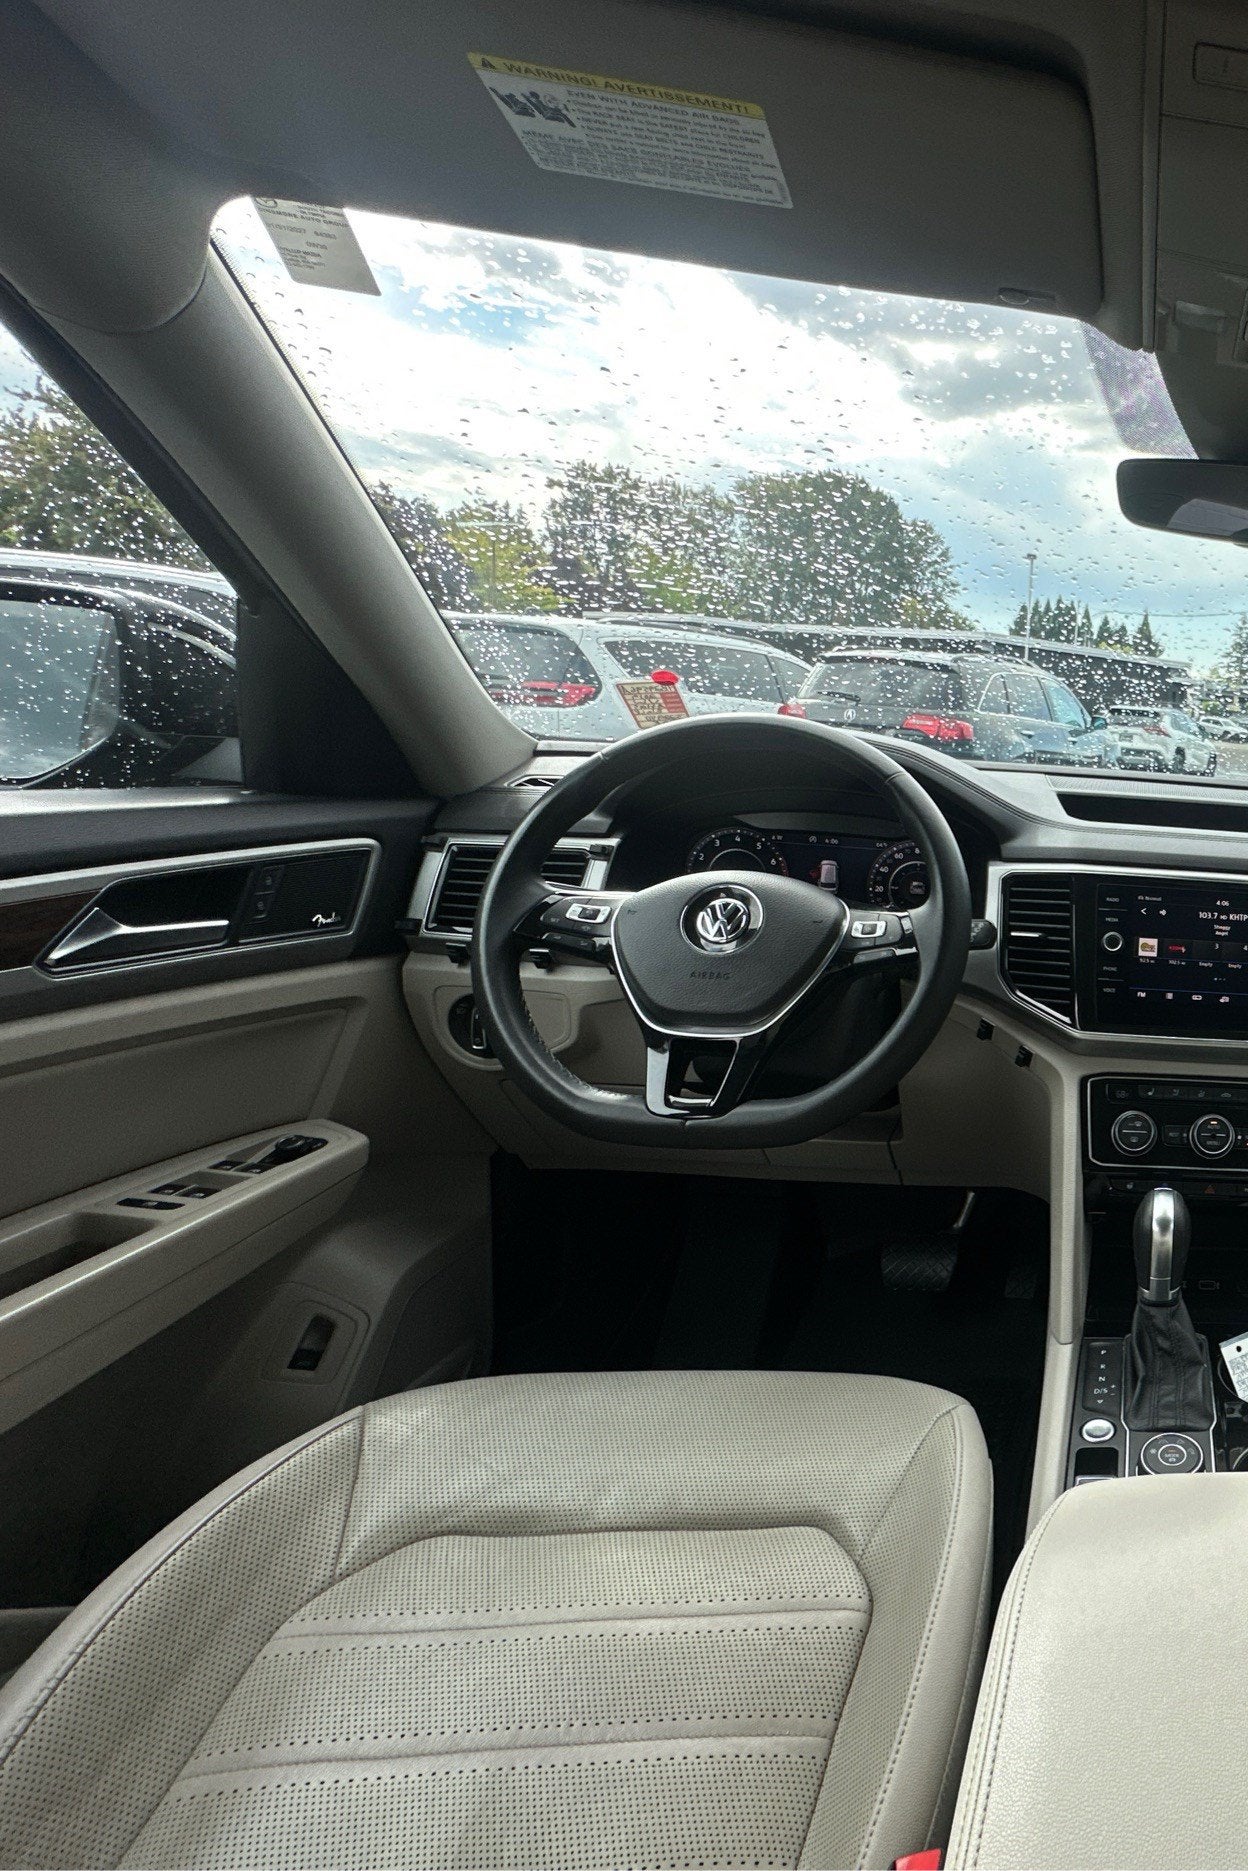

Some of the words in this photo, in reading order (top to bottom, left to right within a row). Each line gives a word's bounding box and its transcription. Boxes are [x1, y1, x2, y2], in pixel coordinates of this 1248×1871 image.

[503, 61, 596, 87] WARNING!
[604, 80, 751, 114] AVERTISSEMENT!
[1198, 911, 1219, 920] 103.7
[1229, 913, 1248, 922] KHTP
[689, 970, 733, 981] AIRBAG
[1093, 1387, 1108, 1395] D/S
